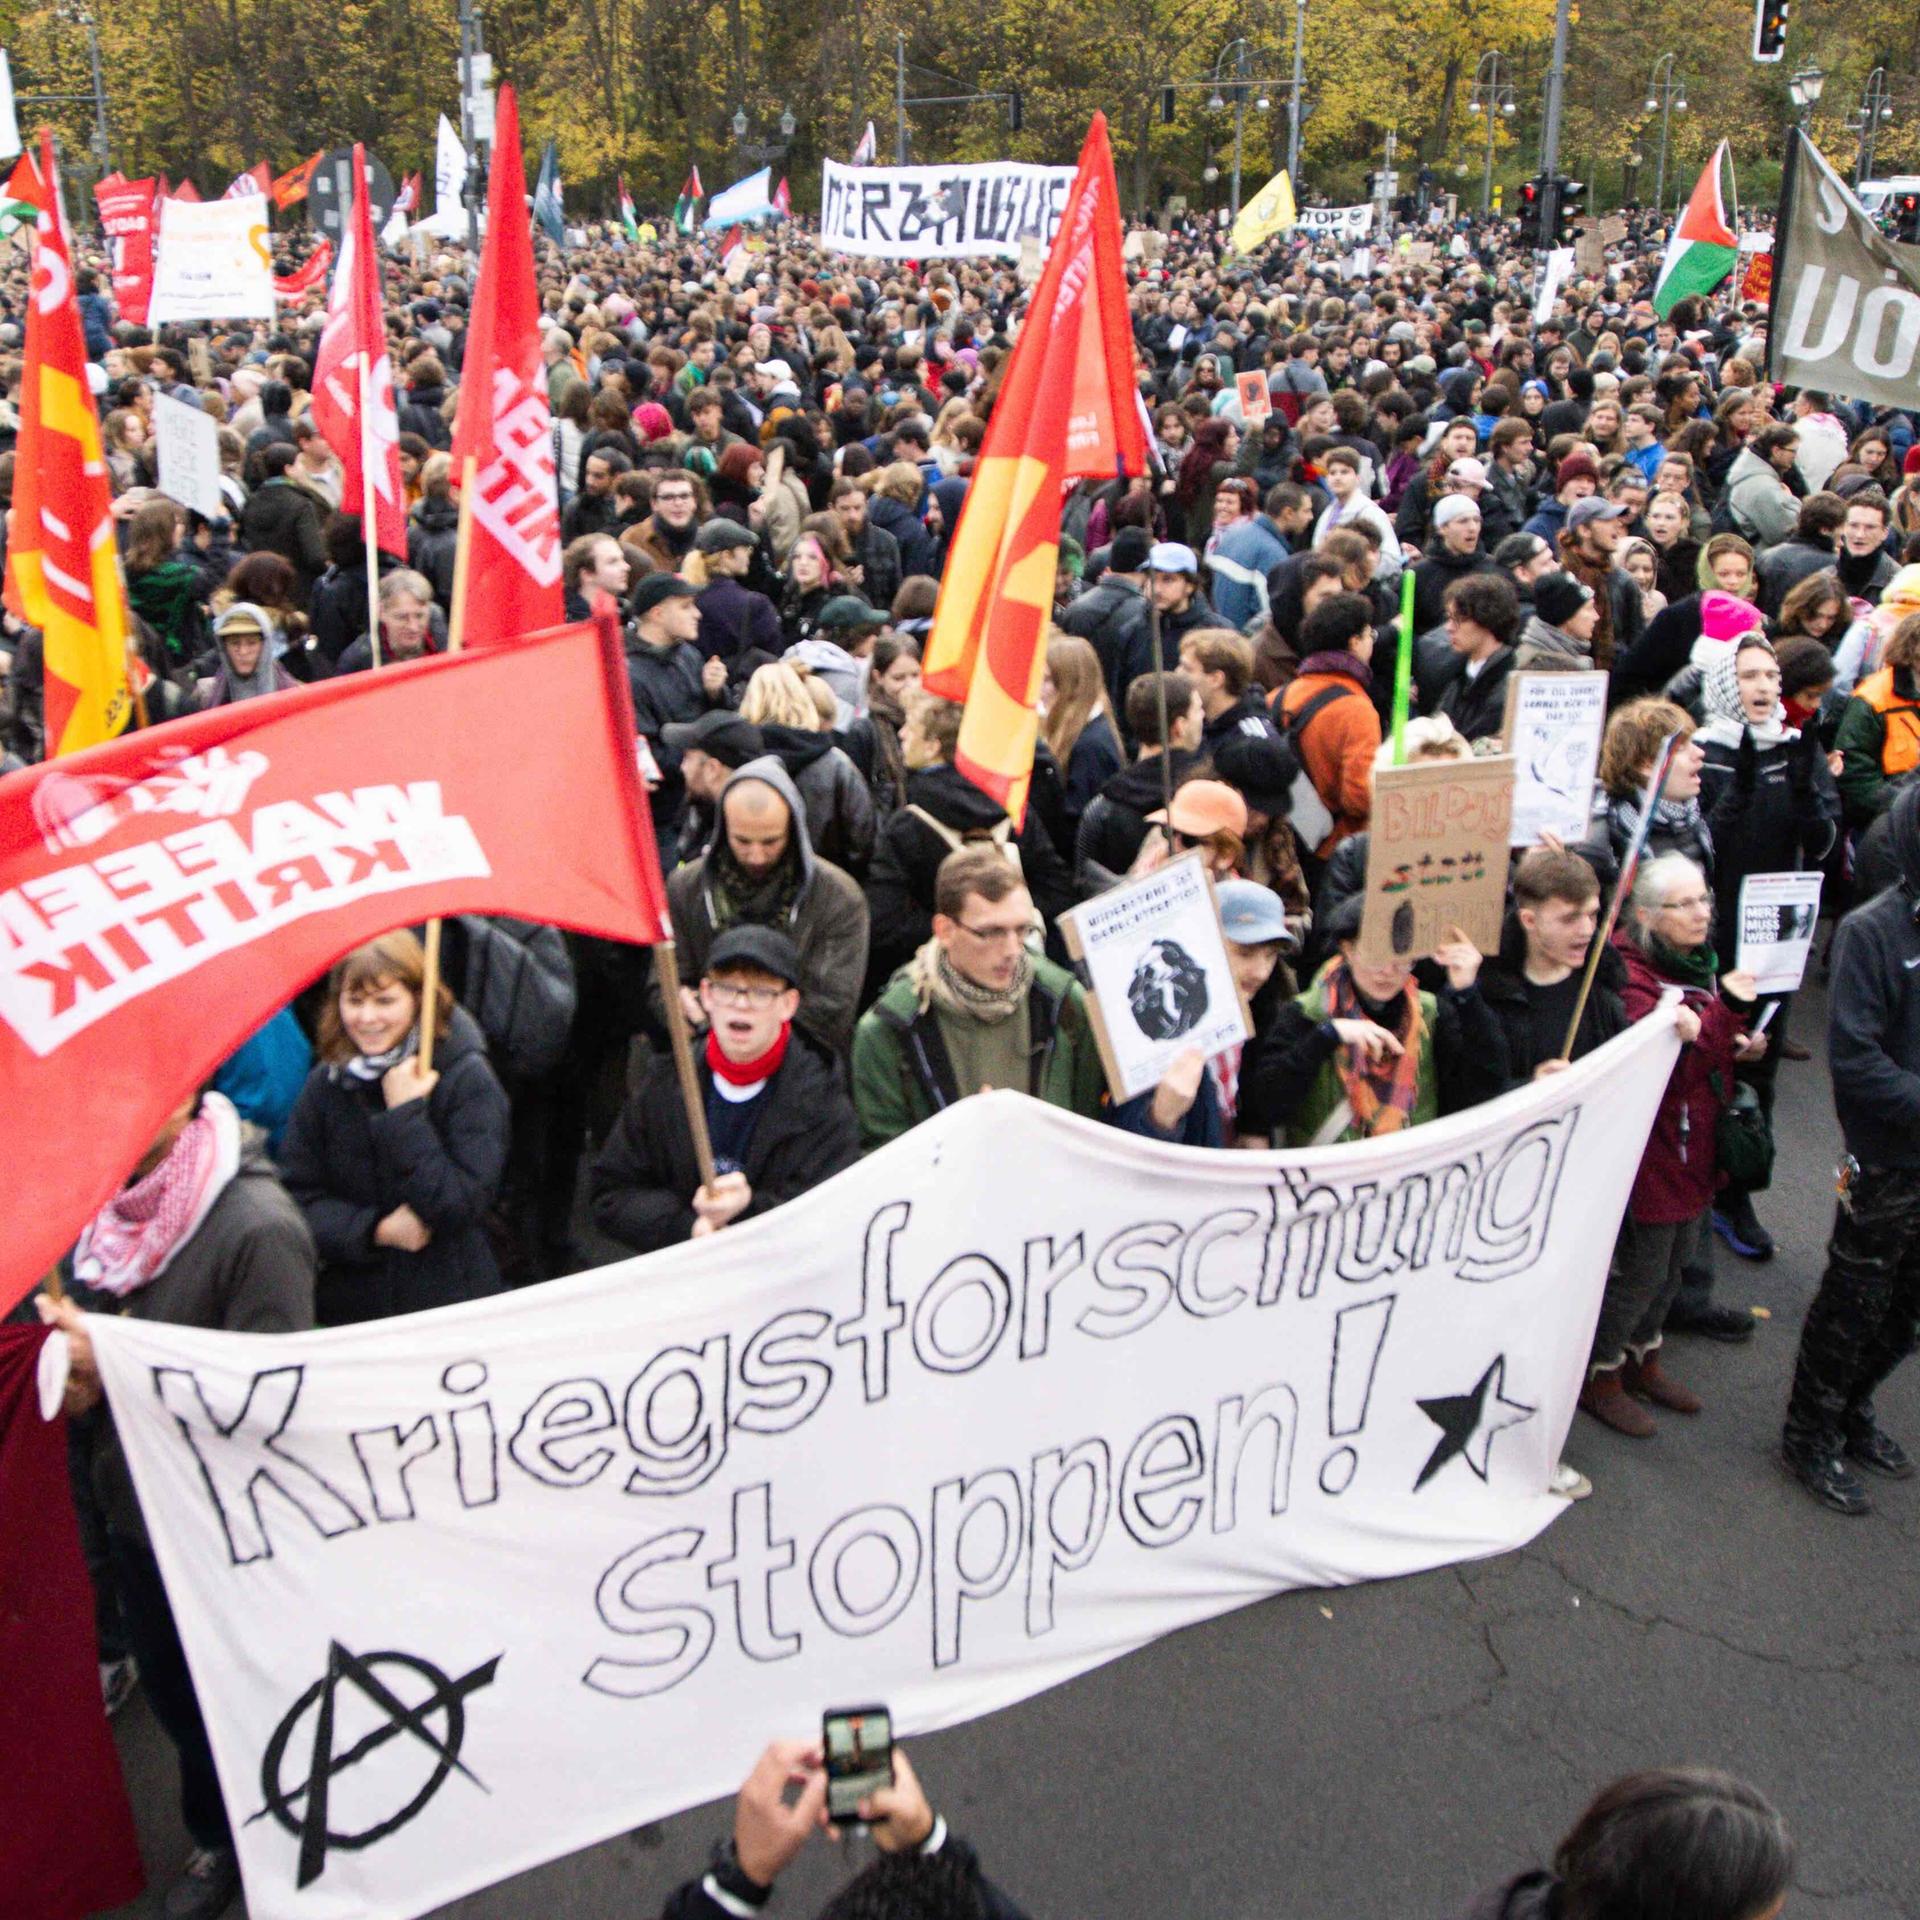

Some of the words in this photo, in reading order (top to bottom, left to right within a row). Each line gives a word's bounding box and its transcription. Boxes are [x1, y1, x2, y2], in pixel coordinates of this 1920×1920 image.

[1745, 905, 1780, 918] MERZ
[1745, 919, 1780, 931] MUSS
[151, 1104, 1582, 1567] Kriegsforschung
